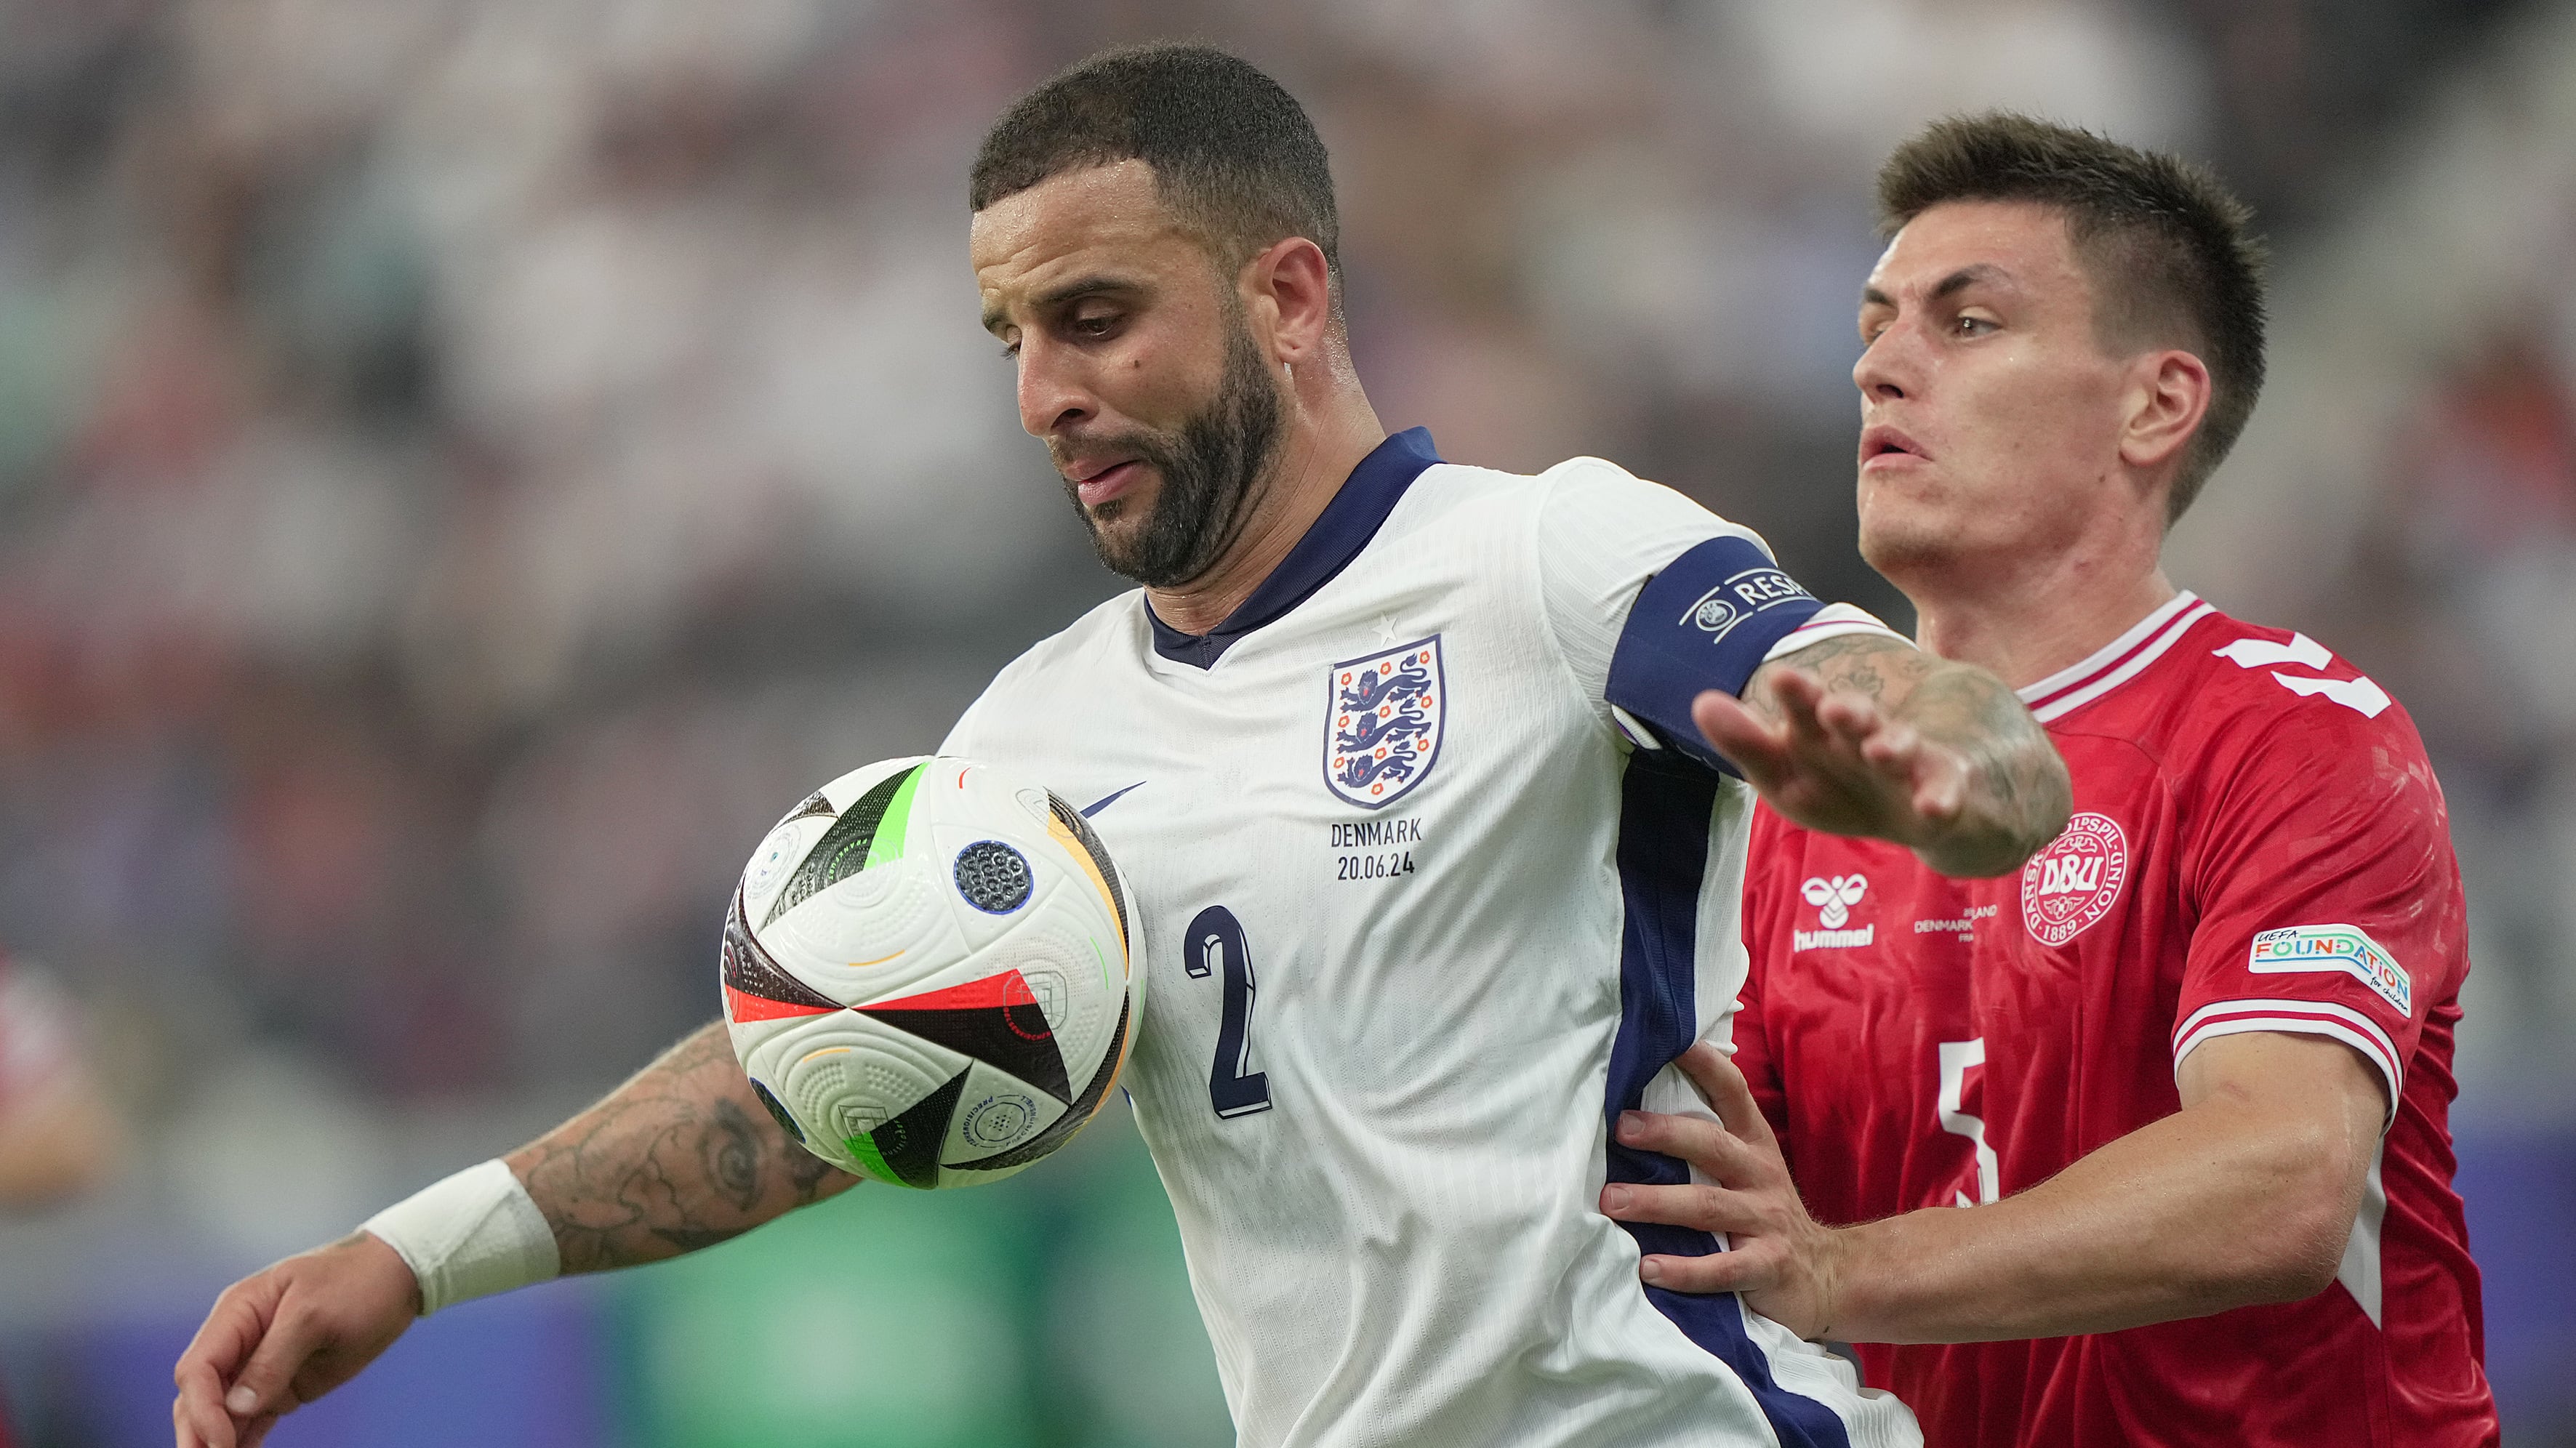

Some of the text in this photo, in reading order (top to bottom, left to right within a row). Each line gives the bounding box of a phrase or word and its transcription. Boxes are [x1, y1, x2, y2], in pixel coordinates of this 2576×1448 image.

[1733, 575, 1812, 606] RESP
[1331, 818, 1421, 848] DENMARK
[829, 838, 867, 880] FRANKFURT
[1338, 851, 1415, 880] 20.06.24
[2039, 854, 2104, 896] DBU
[2084, 852, 2123, 921] UNION
[1794, 923, 1874, 953] hummel
[1914, 920, 1973, 933] DENMARK
[2043, 920, 2077, 942] 1889
[2257, 930, 2299, 943] UEFA
[2370, 976, 2408, 1013] for children
[1184, 905, 1272, 1119] 2
[1938, 1037, 1999, 1208] 5
